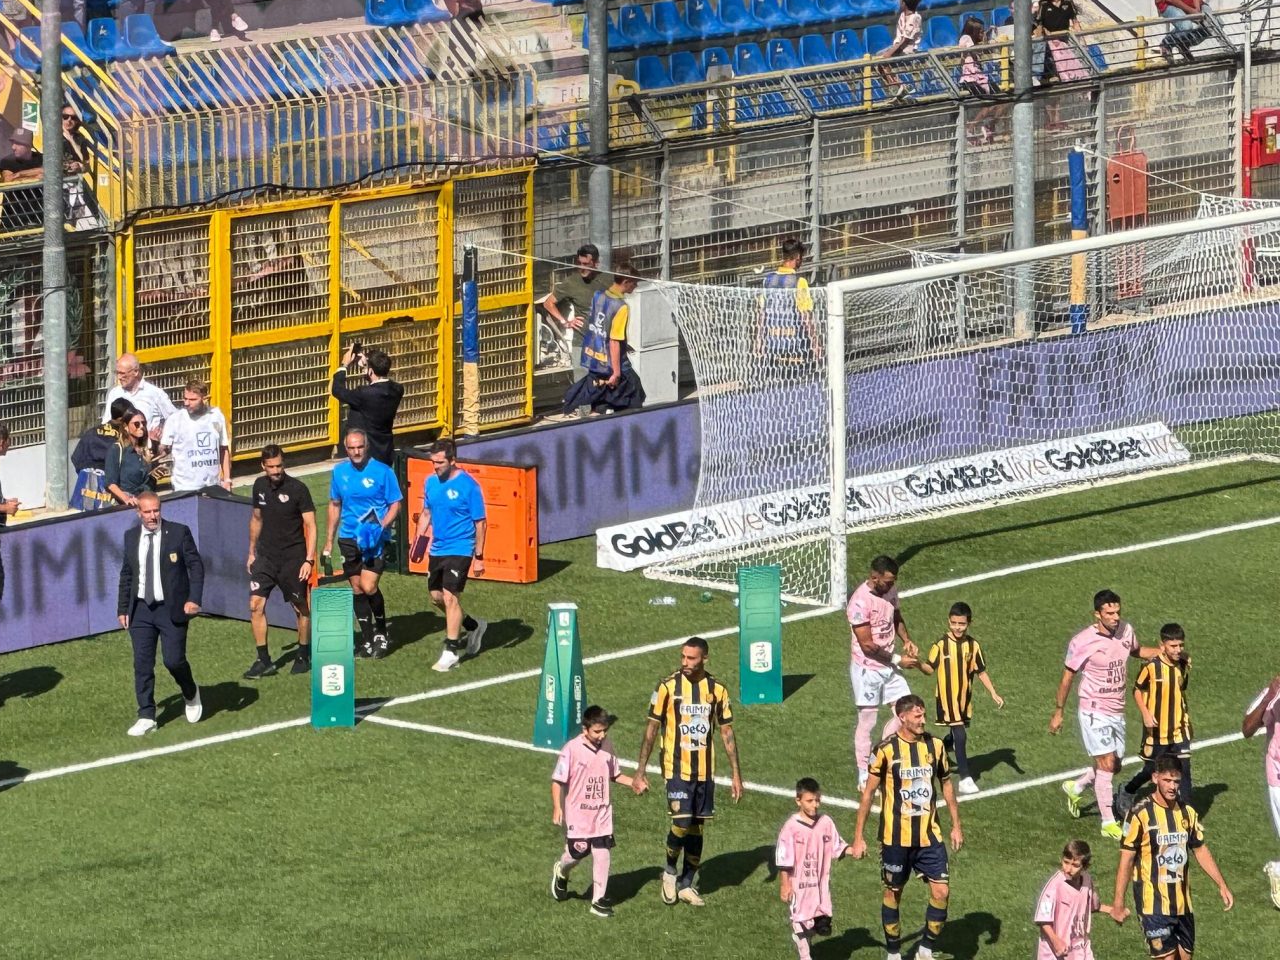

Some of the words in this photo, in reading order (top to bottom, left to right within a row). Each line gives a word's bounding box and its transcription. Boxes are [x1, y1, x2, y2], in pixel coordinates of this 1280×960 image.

[479, 415, 679, 515] RIMM
[1044, 434, 1151, 474] GoldBet
[904, 457, 1015, 498] GoldBet
[609, 515, 723, 559] GoldBet
[716, 506, 765, 538] live
[680, 704, 711, 714] FRIMM
[900, 768, 933, 778] FRIMM
